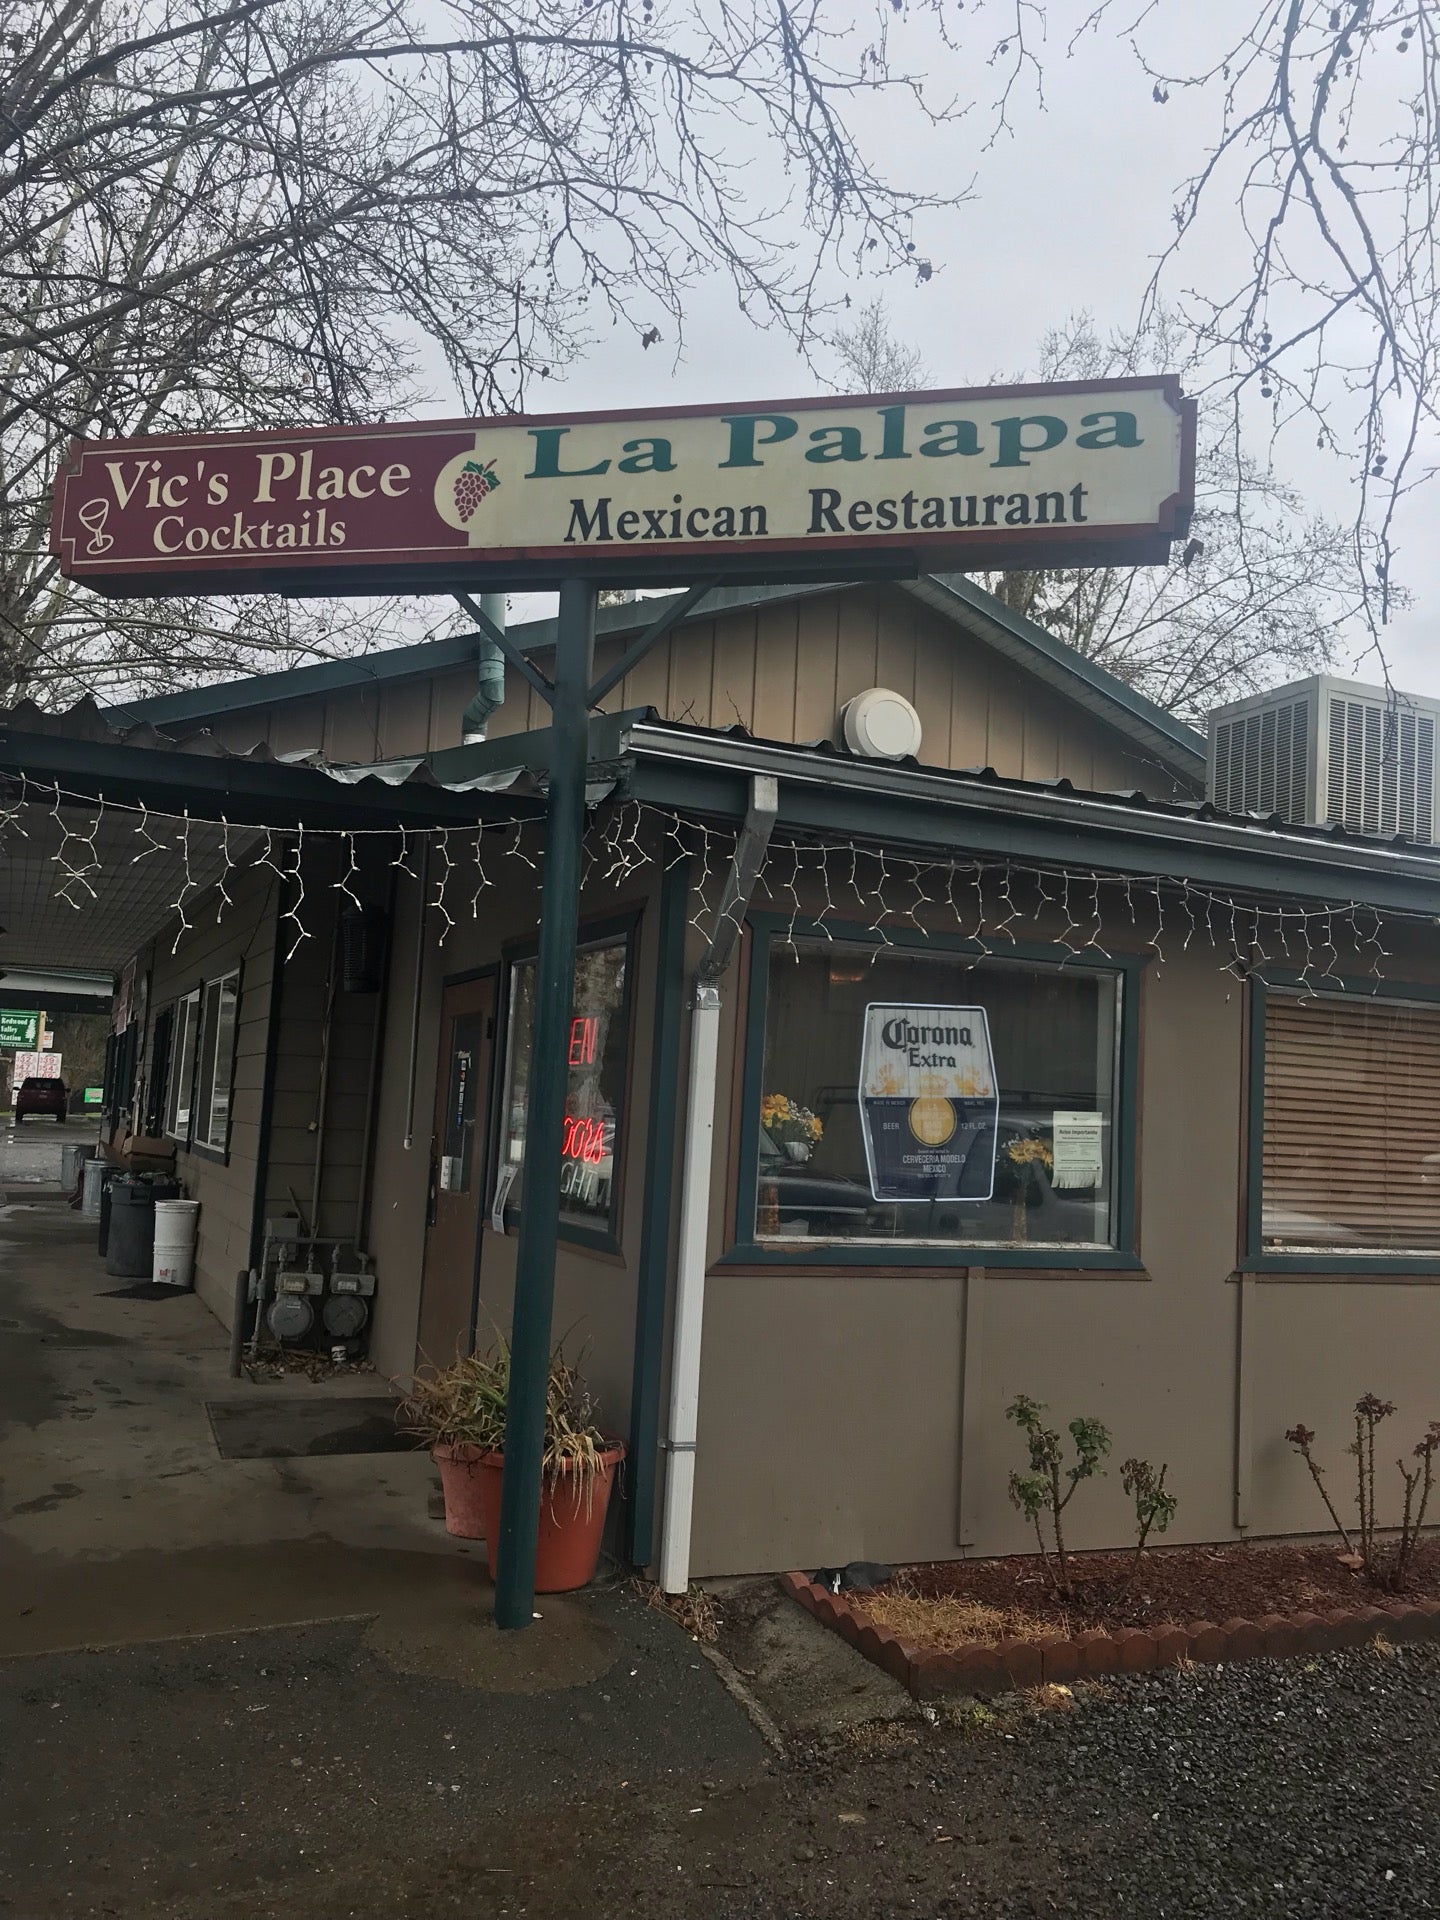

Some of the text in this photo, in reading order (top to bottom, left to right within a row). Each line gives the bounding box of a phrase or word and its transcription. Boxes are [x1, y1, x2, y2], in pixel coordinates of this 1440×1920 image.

[524, 405, 1144, 480] La Palapa
[104, 449, 412, 511] Vic's Place
[153, 508, 347, 555] Cocktails
[564, 481, 1088, 543] Mexican Restaurant
[1, 1017, 28, 1025] Redwood
[568, 1016, 597, 1065] EN
[881, 1018, 974, 1053] Corona
[908, 1047, 957, 1068] Extra
[922, 1164, 947, 1173] MEXICO
[940, 1154, 966, 1164] MODELO
[560, 1161, 599, 1202] GHT
